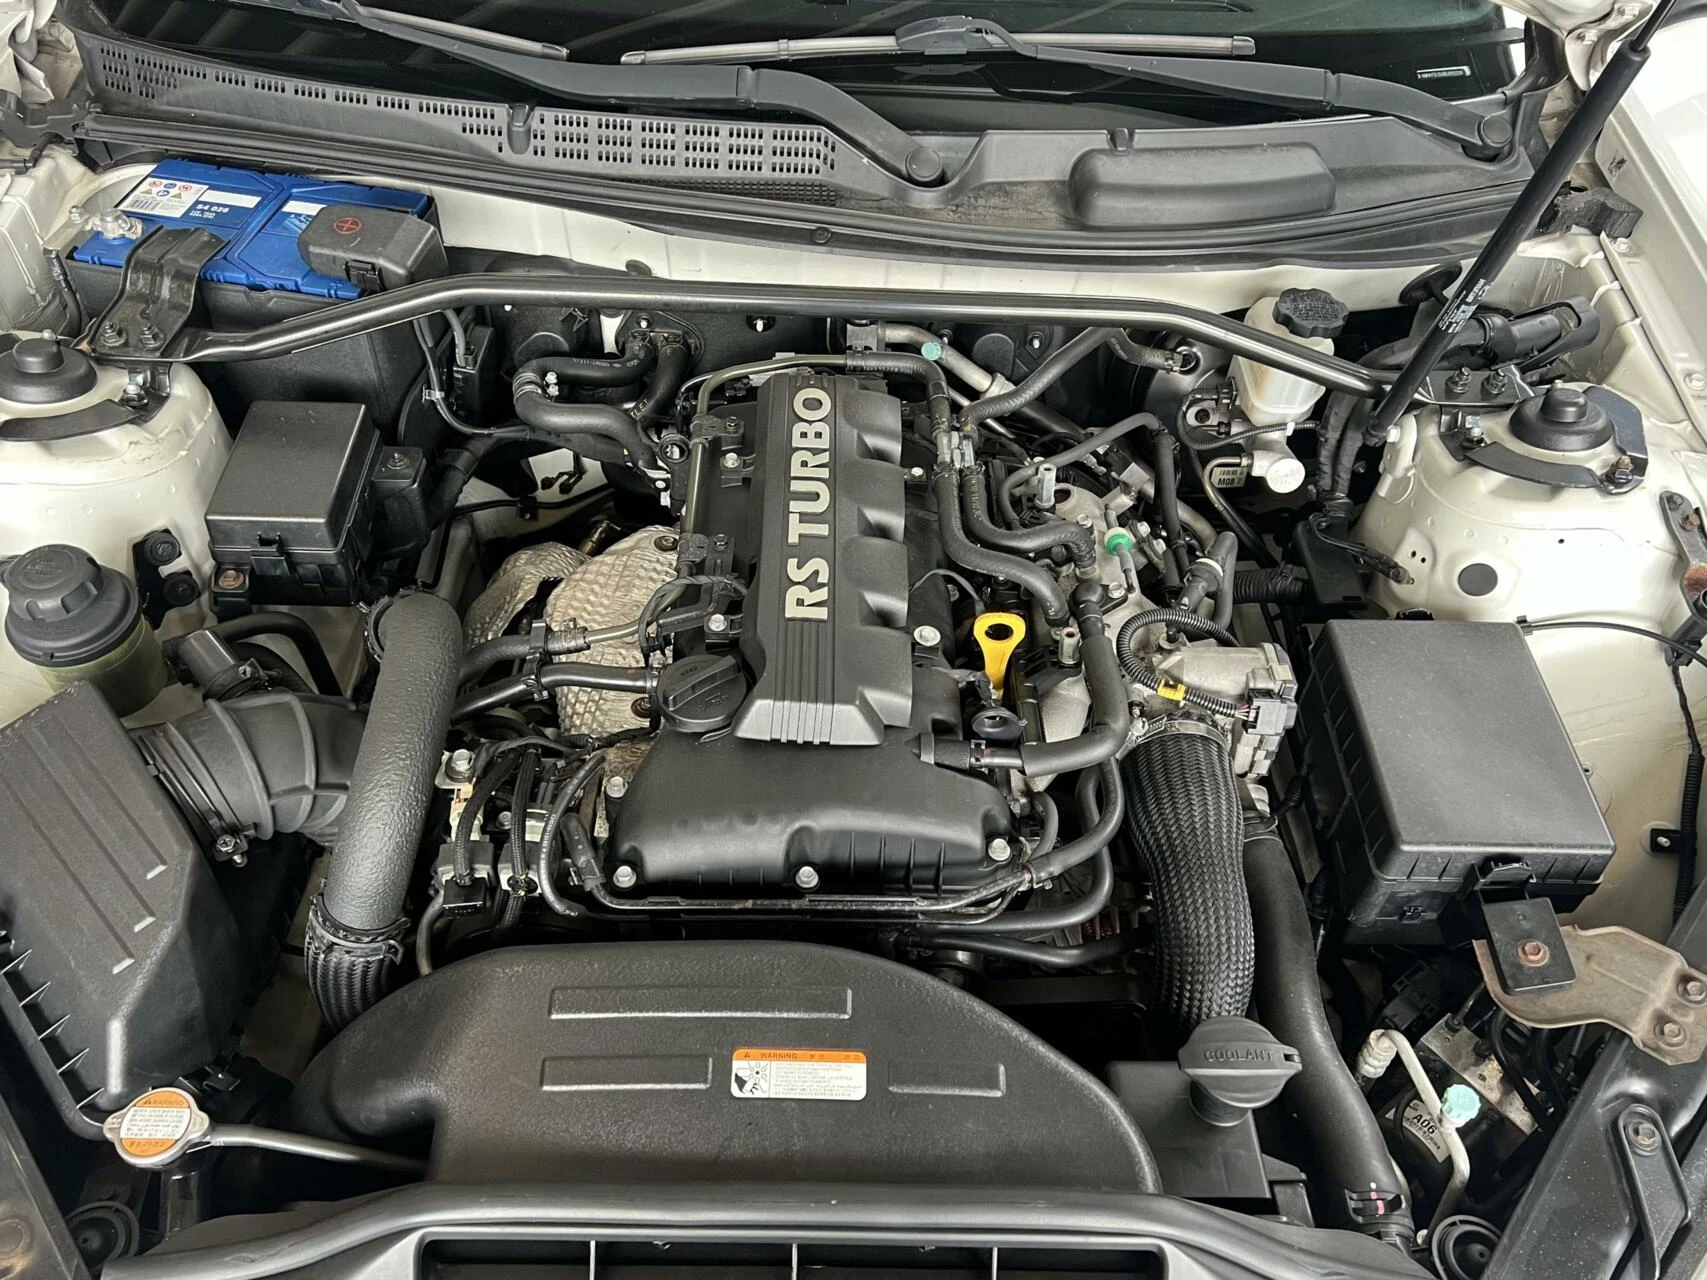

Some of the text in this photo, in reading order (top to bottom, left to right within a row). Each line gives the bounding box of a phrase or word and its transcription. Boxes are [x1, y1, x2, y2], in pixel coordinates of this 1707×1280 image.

[784, 387, 832, 620] RS TURBO
[760, 1052, 798, 1060] WARNING
[1203, 1048, 1273, 1062] COOLANT
[1411, 1113, 1438, 1135] A06
